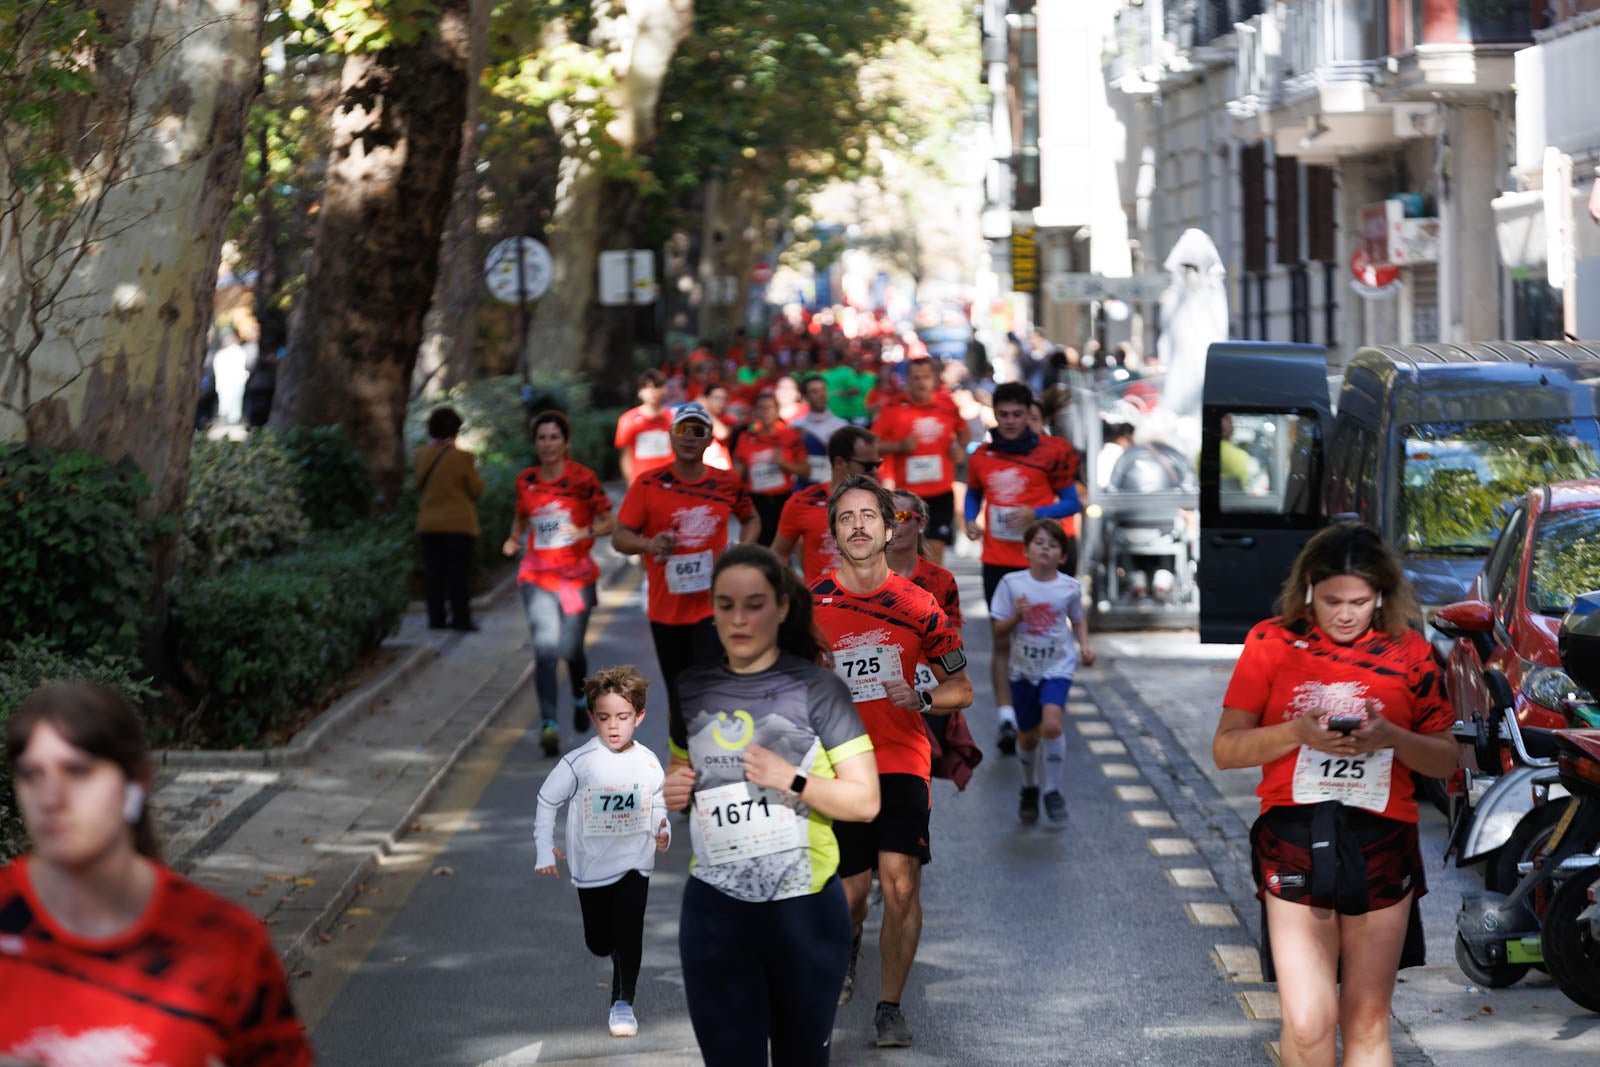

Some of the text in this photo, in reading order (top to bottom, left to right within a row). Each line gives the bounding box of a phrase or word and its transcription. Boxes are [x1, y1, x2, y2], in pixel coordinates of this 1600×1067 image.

[675, 561, 702, 576] 667
[1022, 645, 1056, 659] 1217
[842, 656, 881, 678] 725
[855, 676, 878, 686] TSUNAMI
[1319, 758, 1367, 779] 125
[599, 792, 635, 812] 724
[711, 796, 771, 828] 1671
